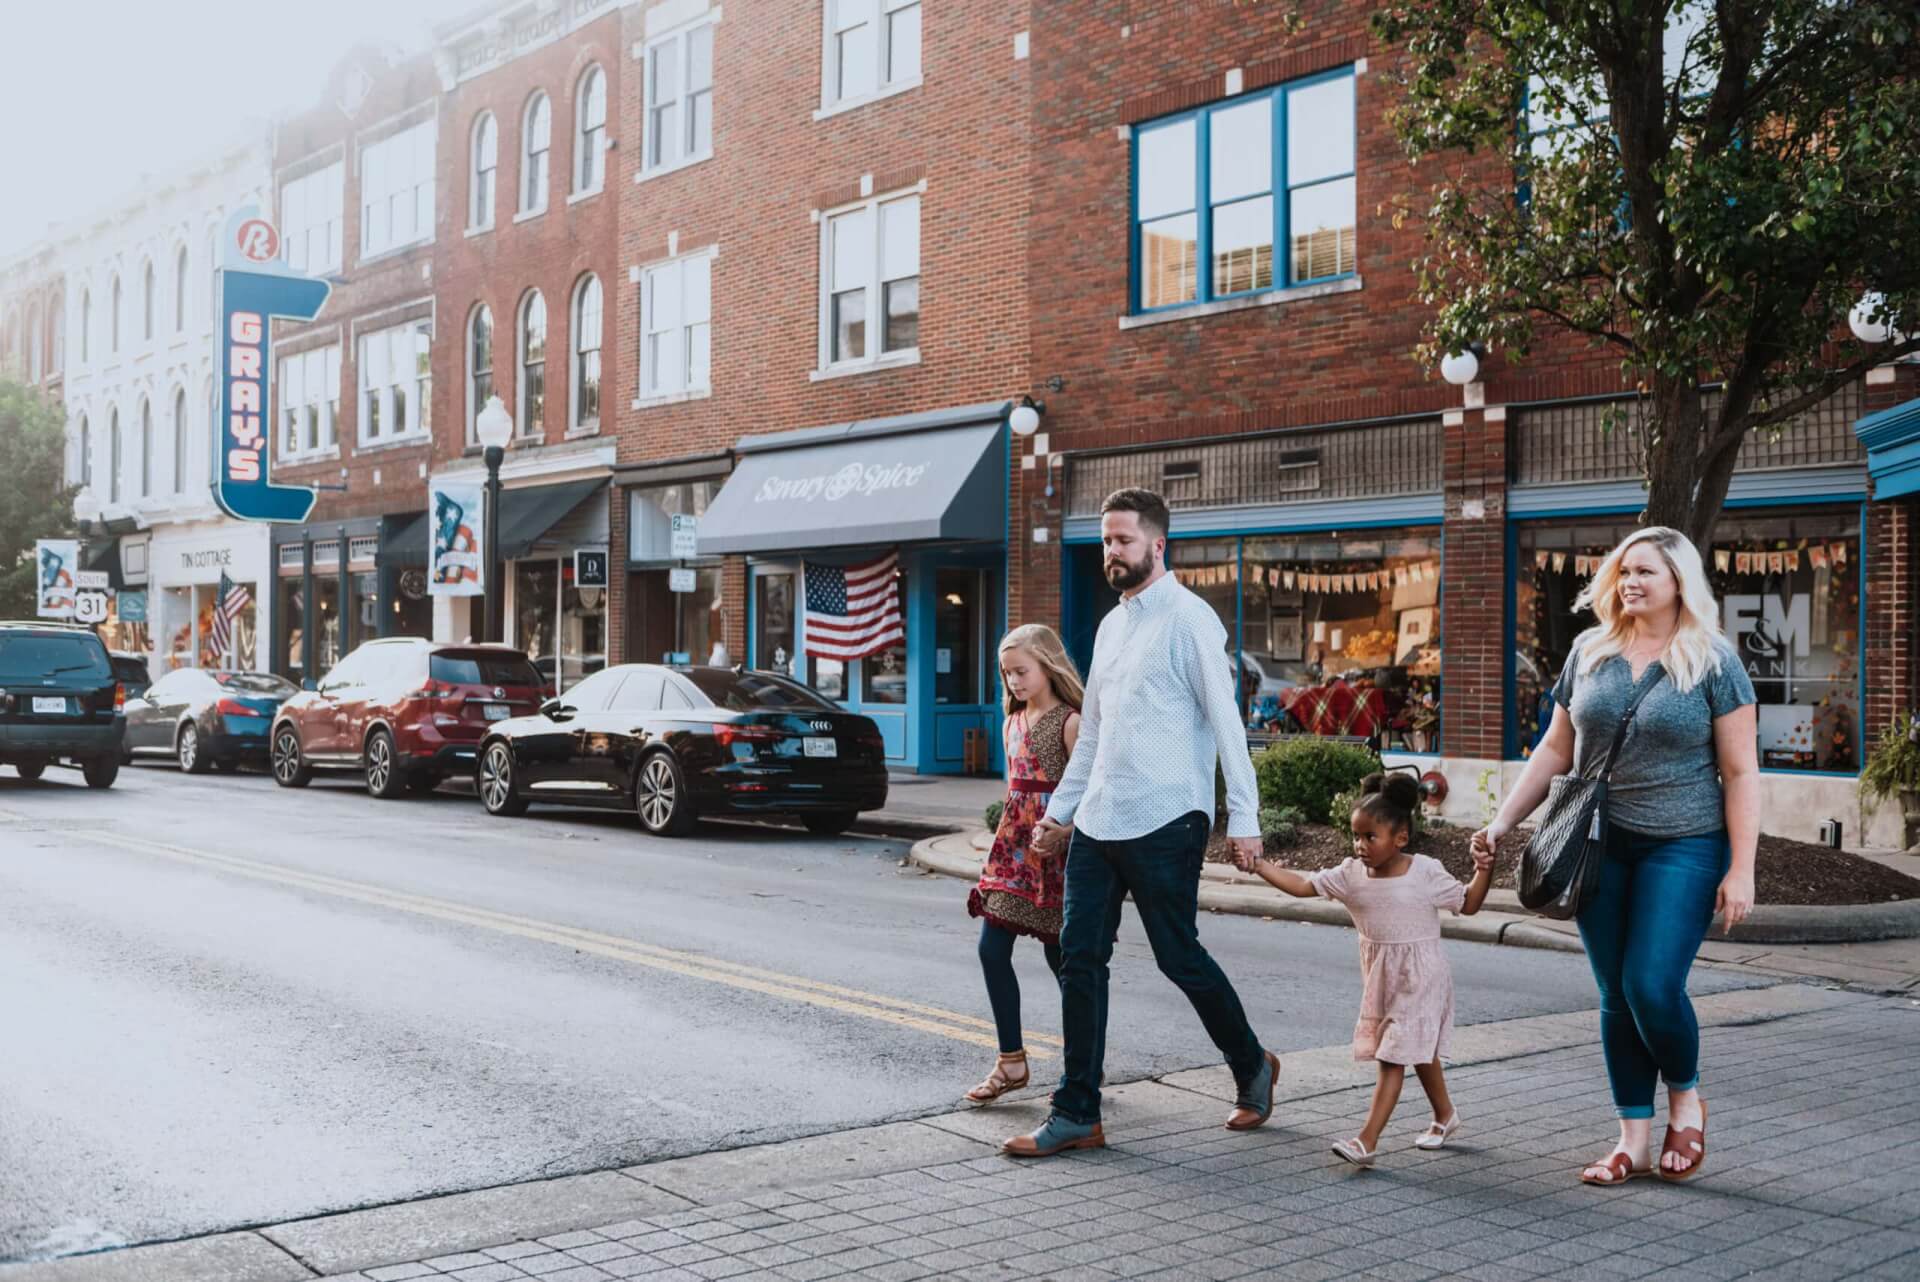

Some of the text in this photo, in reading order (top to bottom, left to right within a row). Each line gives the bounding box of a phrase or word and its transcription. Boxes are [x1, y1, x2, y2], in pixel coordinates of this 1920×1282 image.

[228, 311, 265, 481] GRAY'S
[755, 462, 924, 503] Savory Spice
[181, 548, 232, 569] TIN COTTAGE
[77, 575, 107, 585] SOUTH
[82, 598, 100, 616] 31
[1747, 660, 1809, 677] ANK
